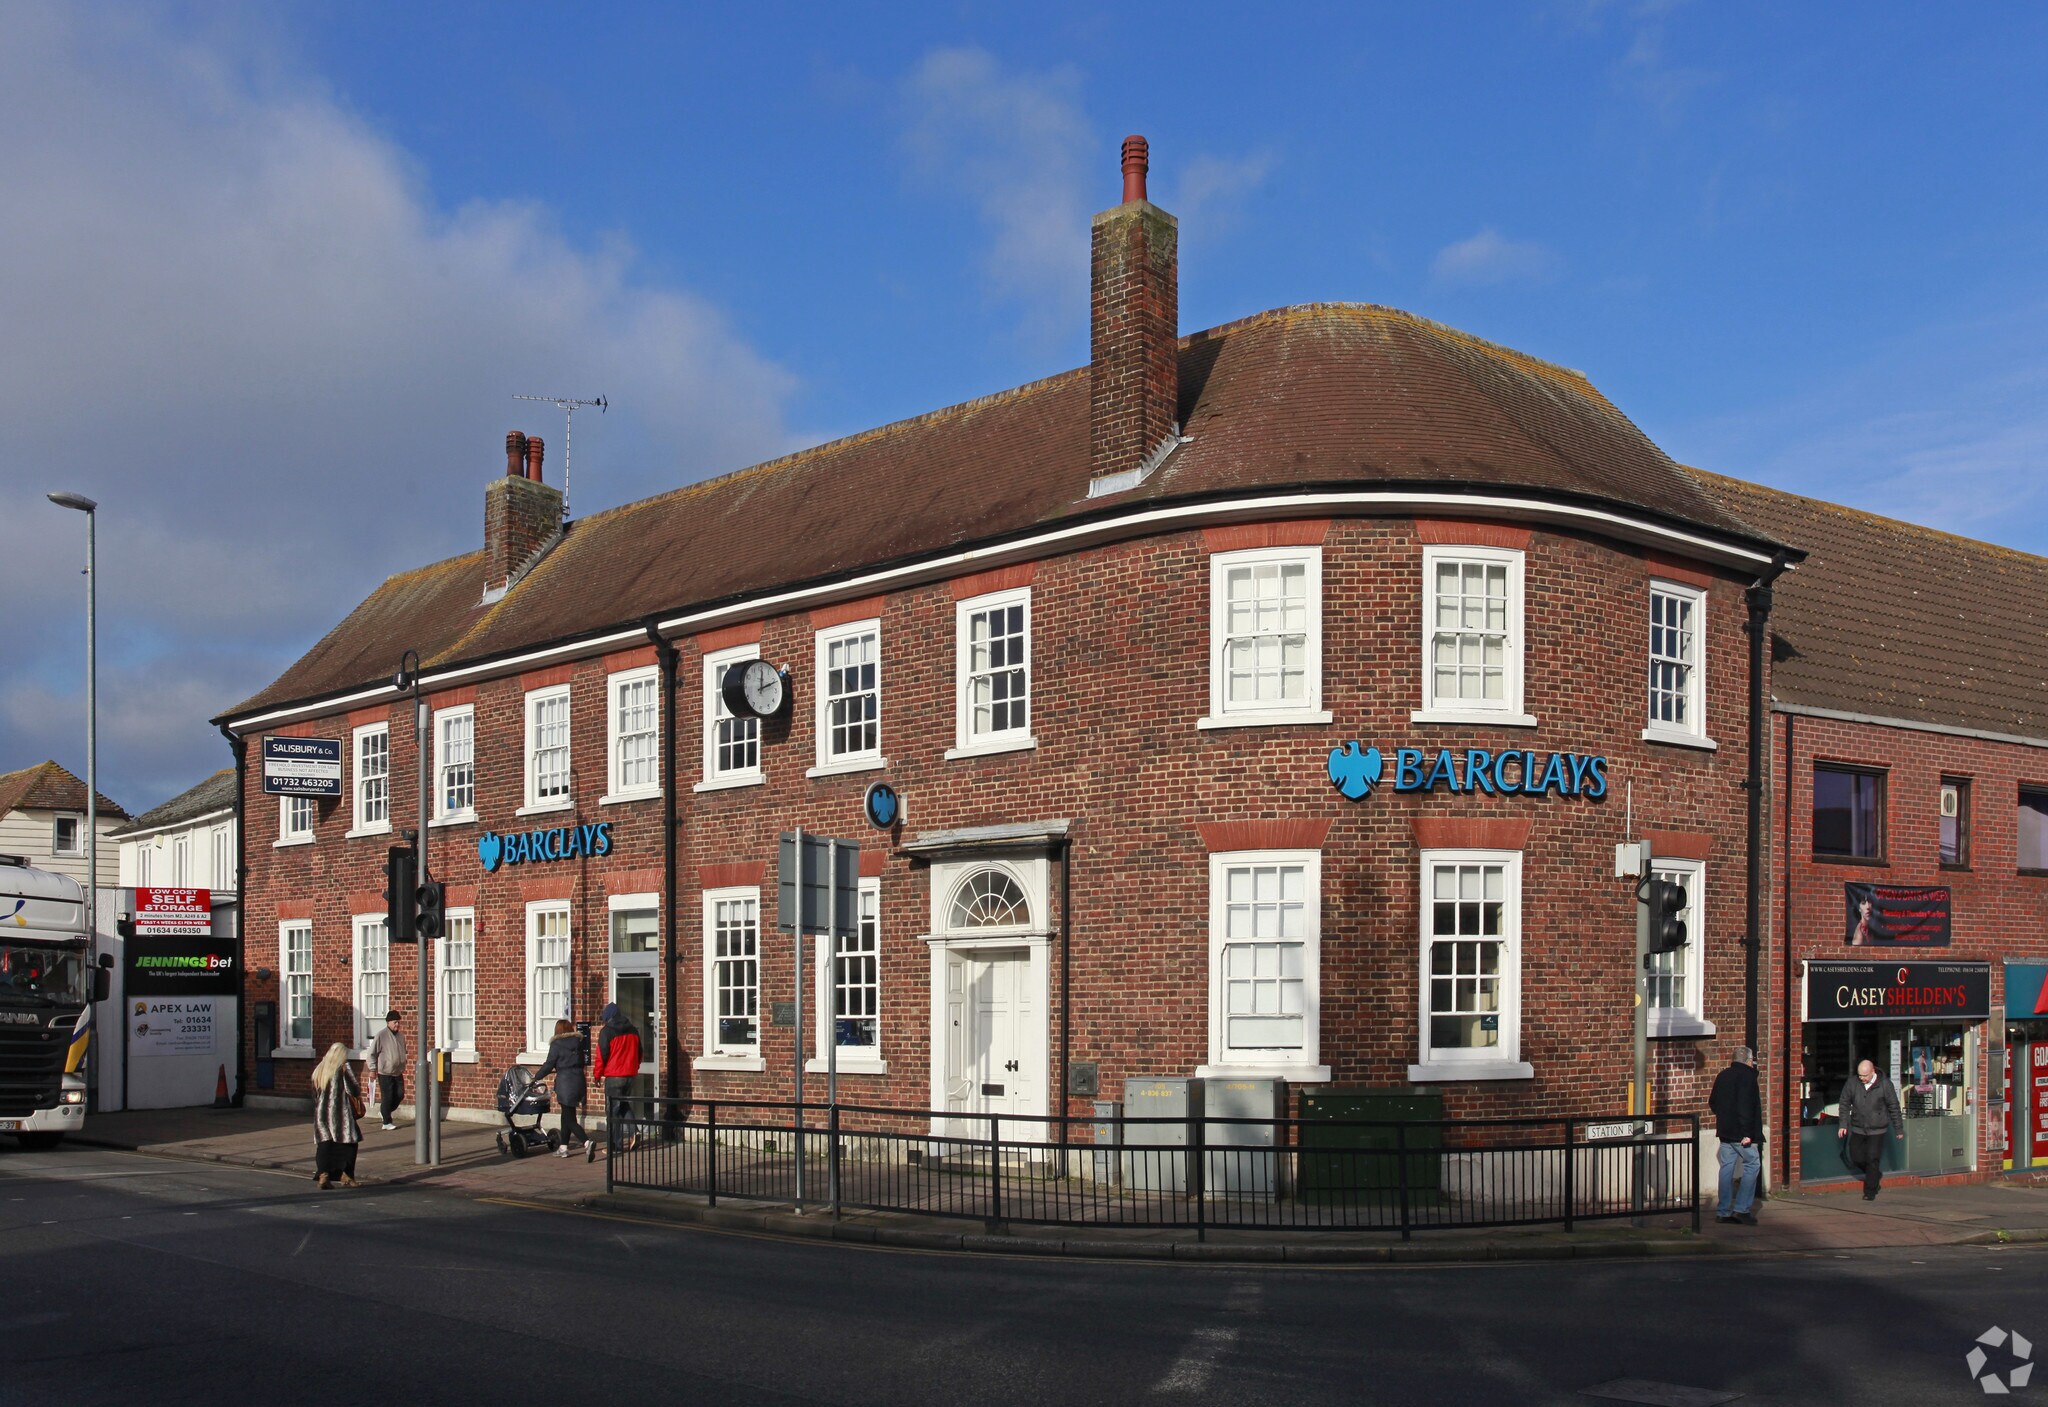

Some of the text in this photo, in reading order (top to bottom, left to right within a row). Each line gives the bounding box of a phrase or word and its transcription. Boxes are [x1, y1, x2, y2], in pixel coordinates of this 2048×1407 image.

[272, 743, 318, 754] SALISBURY
[1393, 748, 1608, 800] BARCLAYS
[272, 777, 334, 788] 01732 463205
[503, 821, 613, 865] BARCLAYS
[151, 894, 197, 905] SELF
[144, 903, 203, 912] STORAGE
[146, 926, 171, 934] 01634
[135, 956, 233, 968] JENNINGSbet
[150, 1003, 212, 1013] APEX LAW
[186, 1016, 212, 1024] 01634
[181, 1025, 212, 1033] 233331
[1591, 1122, 1649, 1138] STATION RD
